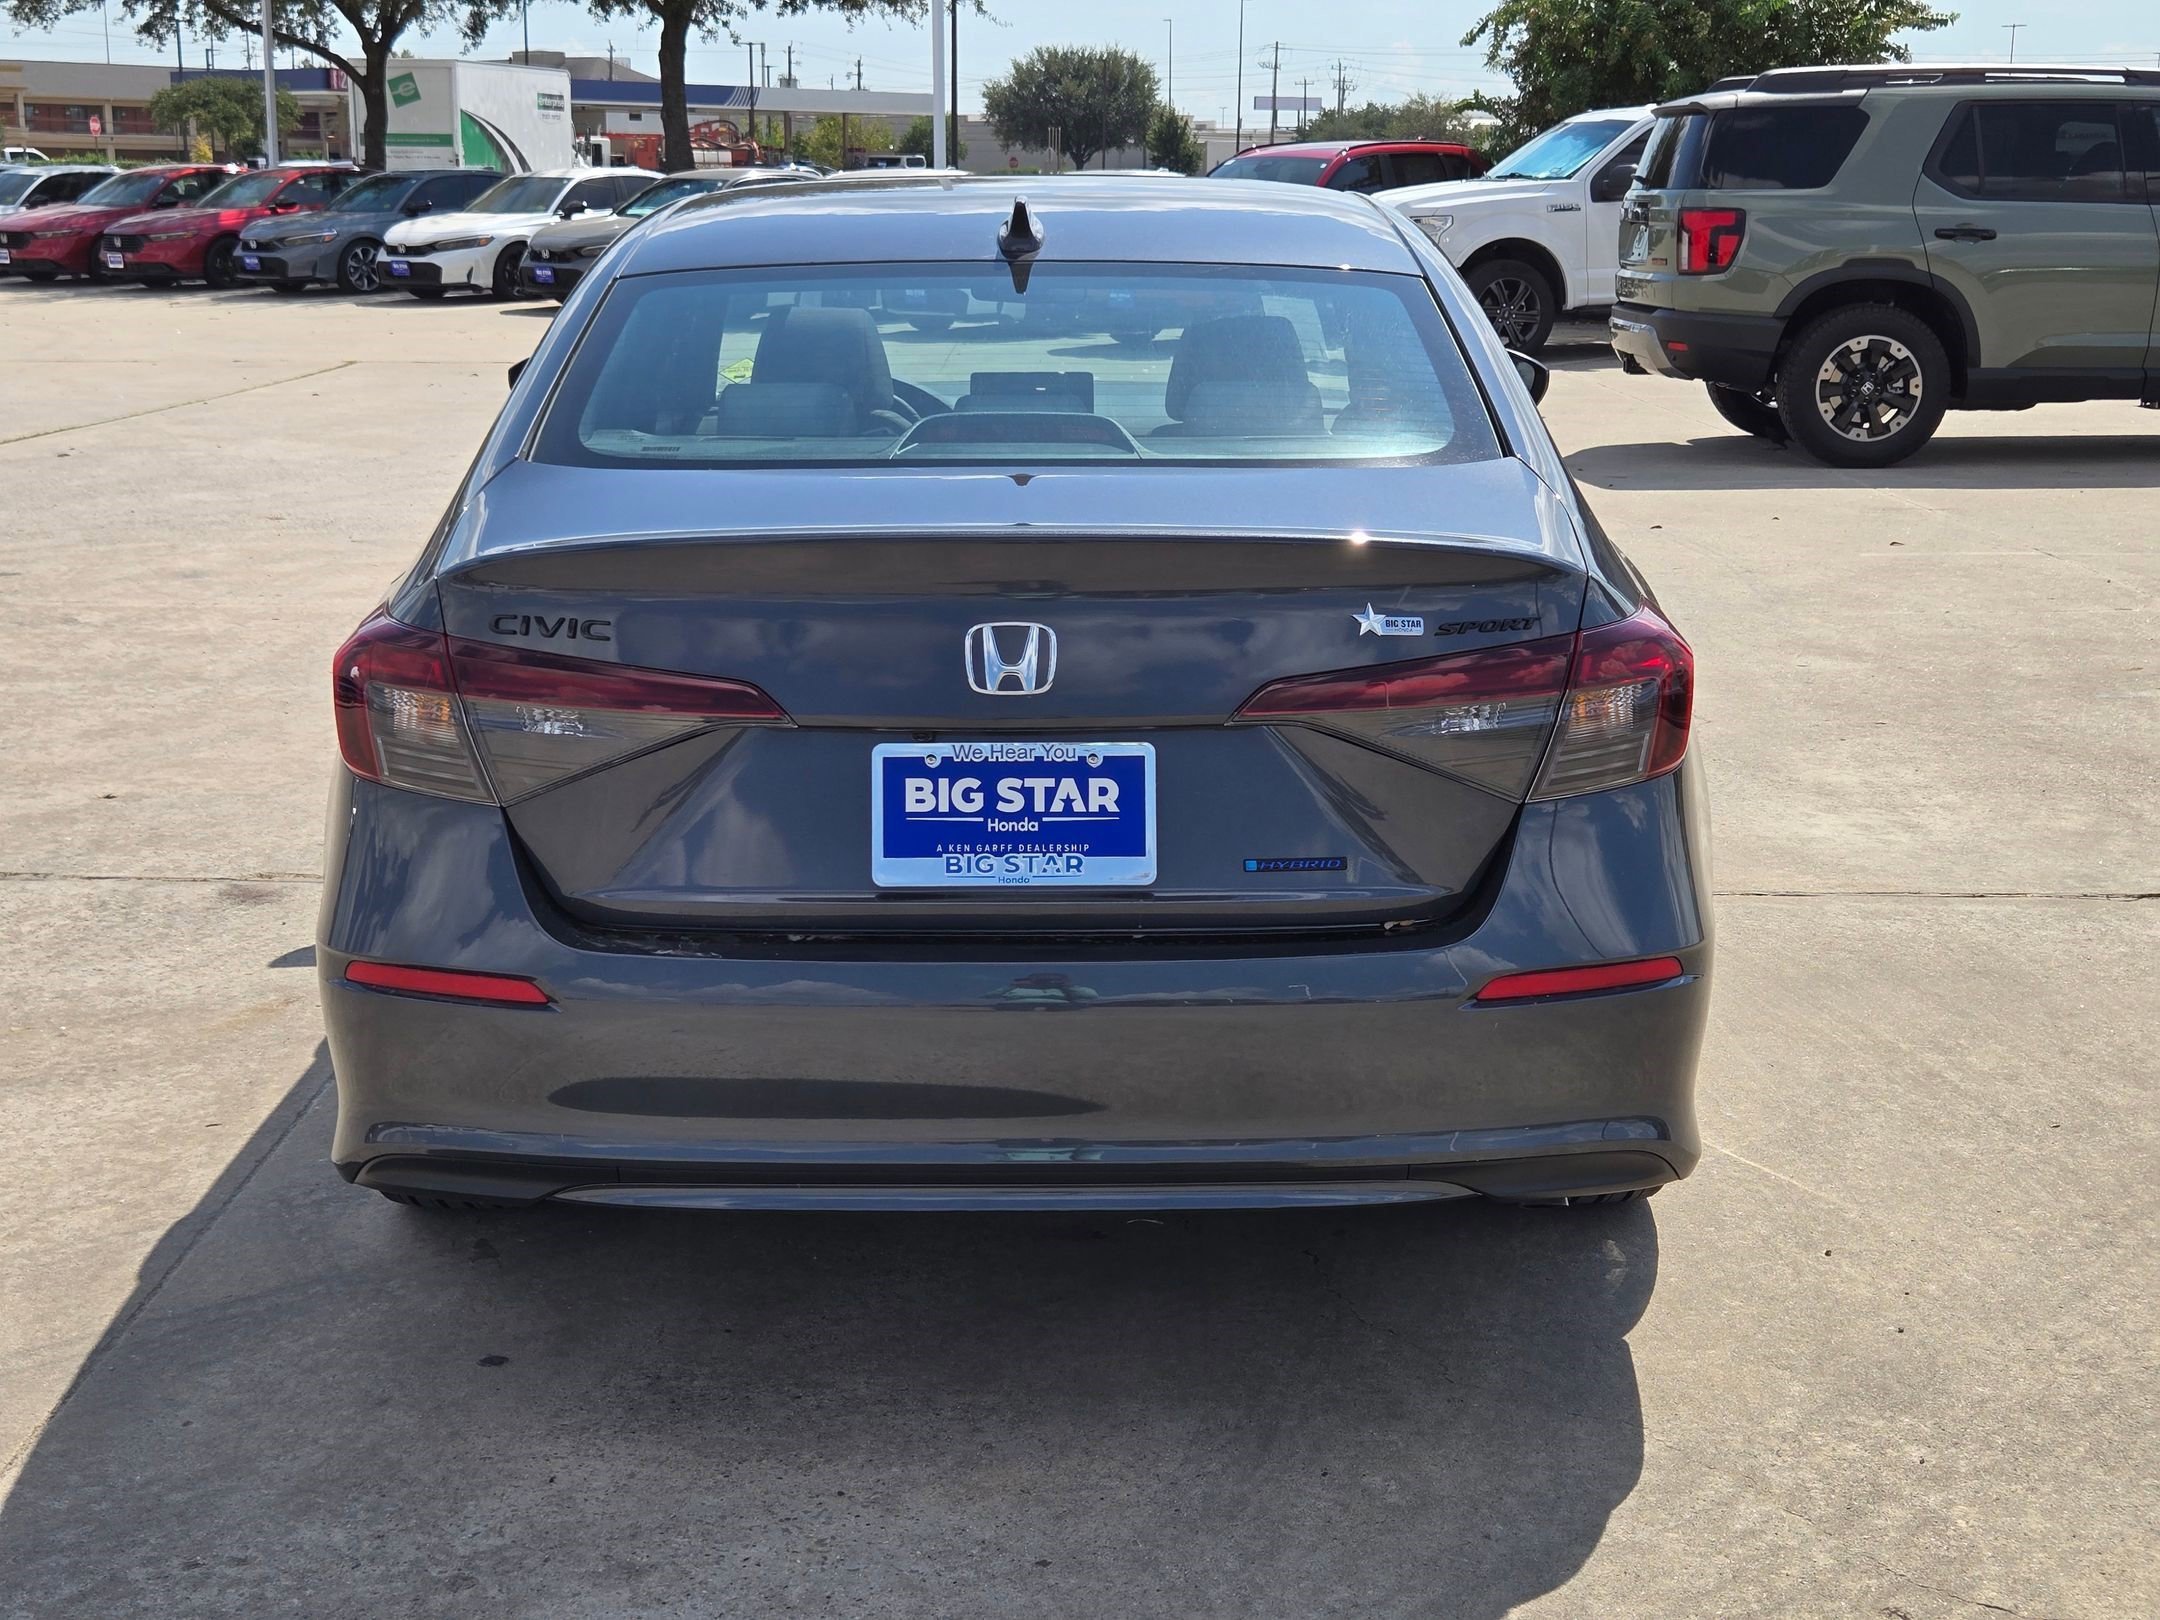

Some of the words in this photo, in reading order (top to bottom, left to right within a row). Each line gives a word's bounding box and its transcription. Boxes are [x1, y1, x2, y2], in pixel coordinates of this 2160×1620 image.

[488, 614, 612, 641] CIVIC
[1385, 619, 1399, 628] BIG
[1400, 619, 1422, 628] STAR
[1434, 617, 1542, 637] SPORT
[952, 744, 984, 760] We
[990, 744, 1036, 760] Hear
[1041, 744, 1077, 760] You
[904, 777, 984, 813] BIG
[995, 777, 1121, 813] STAR
[987, 816, 1039, 832] Honda
[936, 843, 943, 852] A
[948, 843, 971, 852] KEN
[976, 843, 1013, 852] GARFF
[1018, 843, 1090, 852] DEALERSHIP
[945, 855, 994, 874] BIG
[1004, 855, 1084, 874] STAR
[1260, 860, 1341, 870] HYBRID
[998, 876, 1030, 884] Honda
